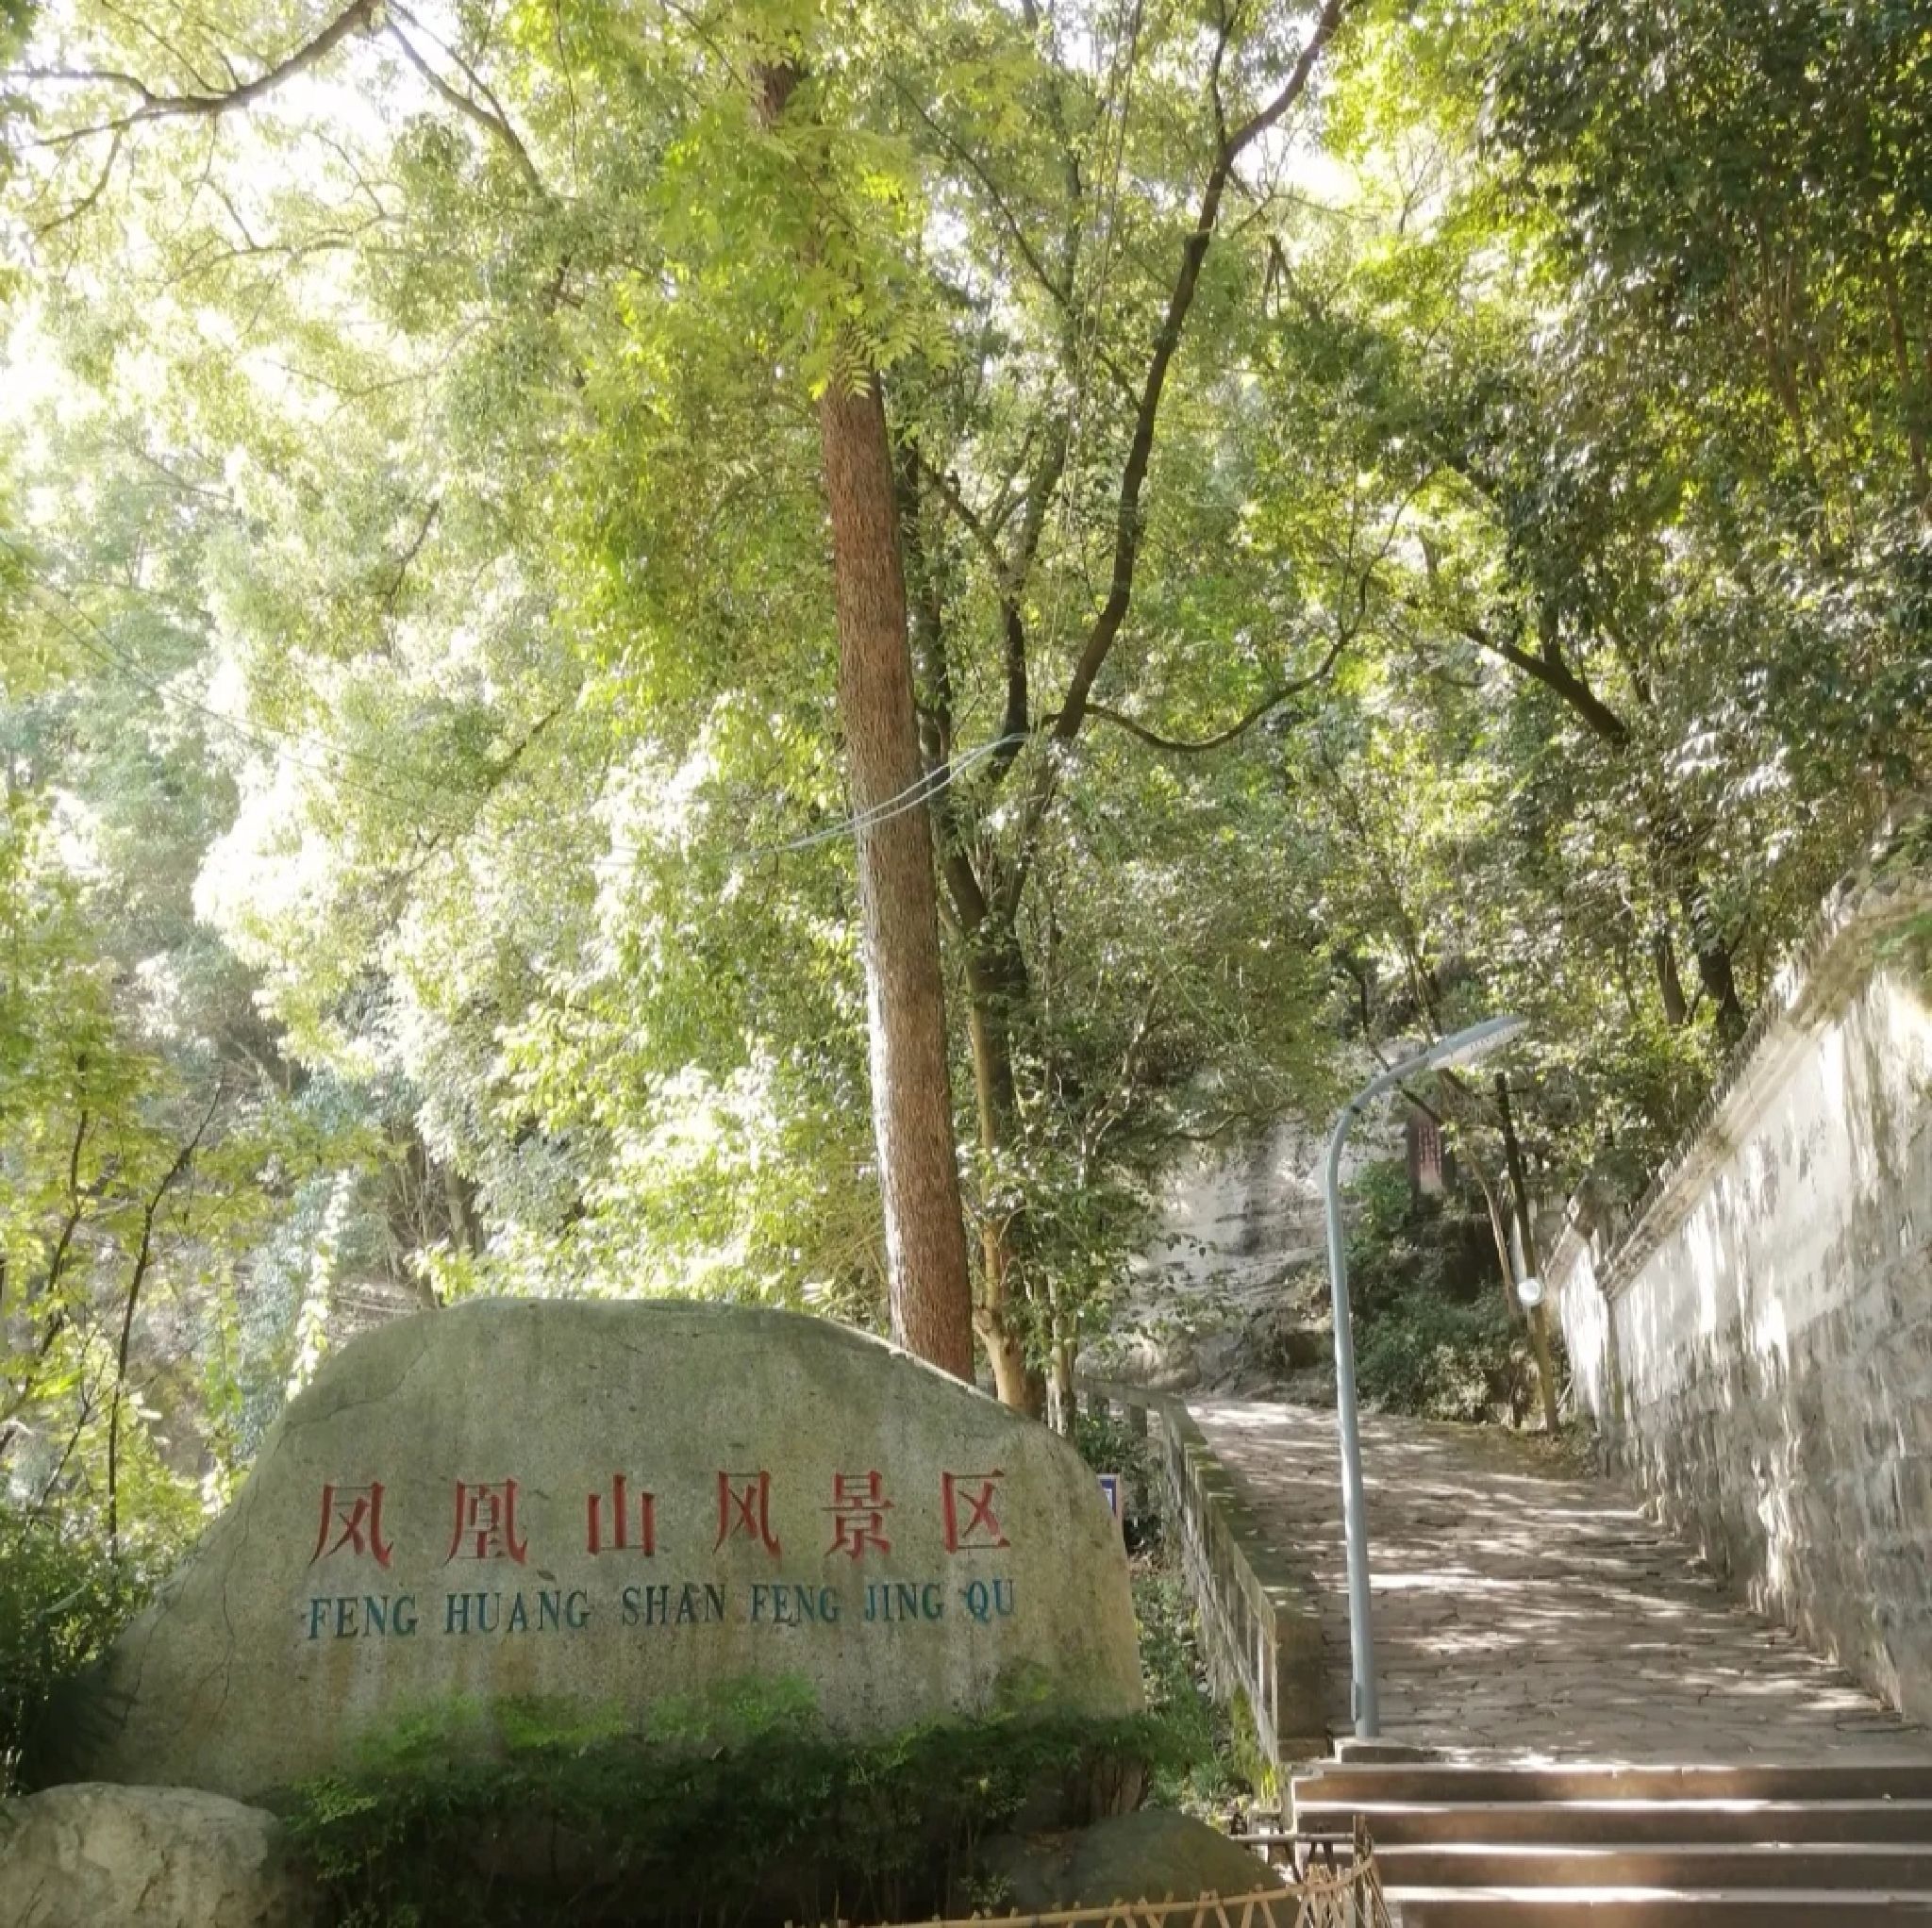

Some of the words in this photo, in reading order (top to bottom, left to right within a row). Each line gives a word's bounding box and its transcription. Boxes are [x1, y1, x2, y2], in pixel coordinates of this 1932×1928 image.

[308, 1470, 1011, 1568] 凤凰山风景区
[308, 1595, 418, 1639] FENG
[444, 1588, 591, 1635] HUANG
[622, 1583, 725, 1626] SHAN
[752, 1584, 839, 1626] FENG
[864, 1582, 942, 1622] JING
[966, 1579, 1015, 1622] QU
